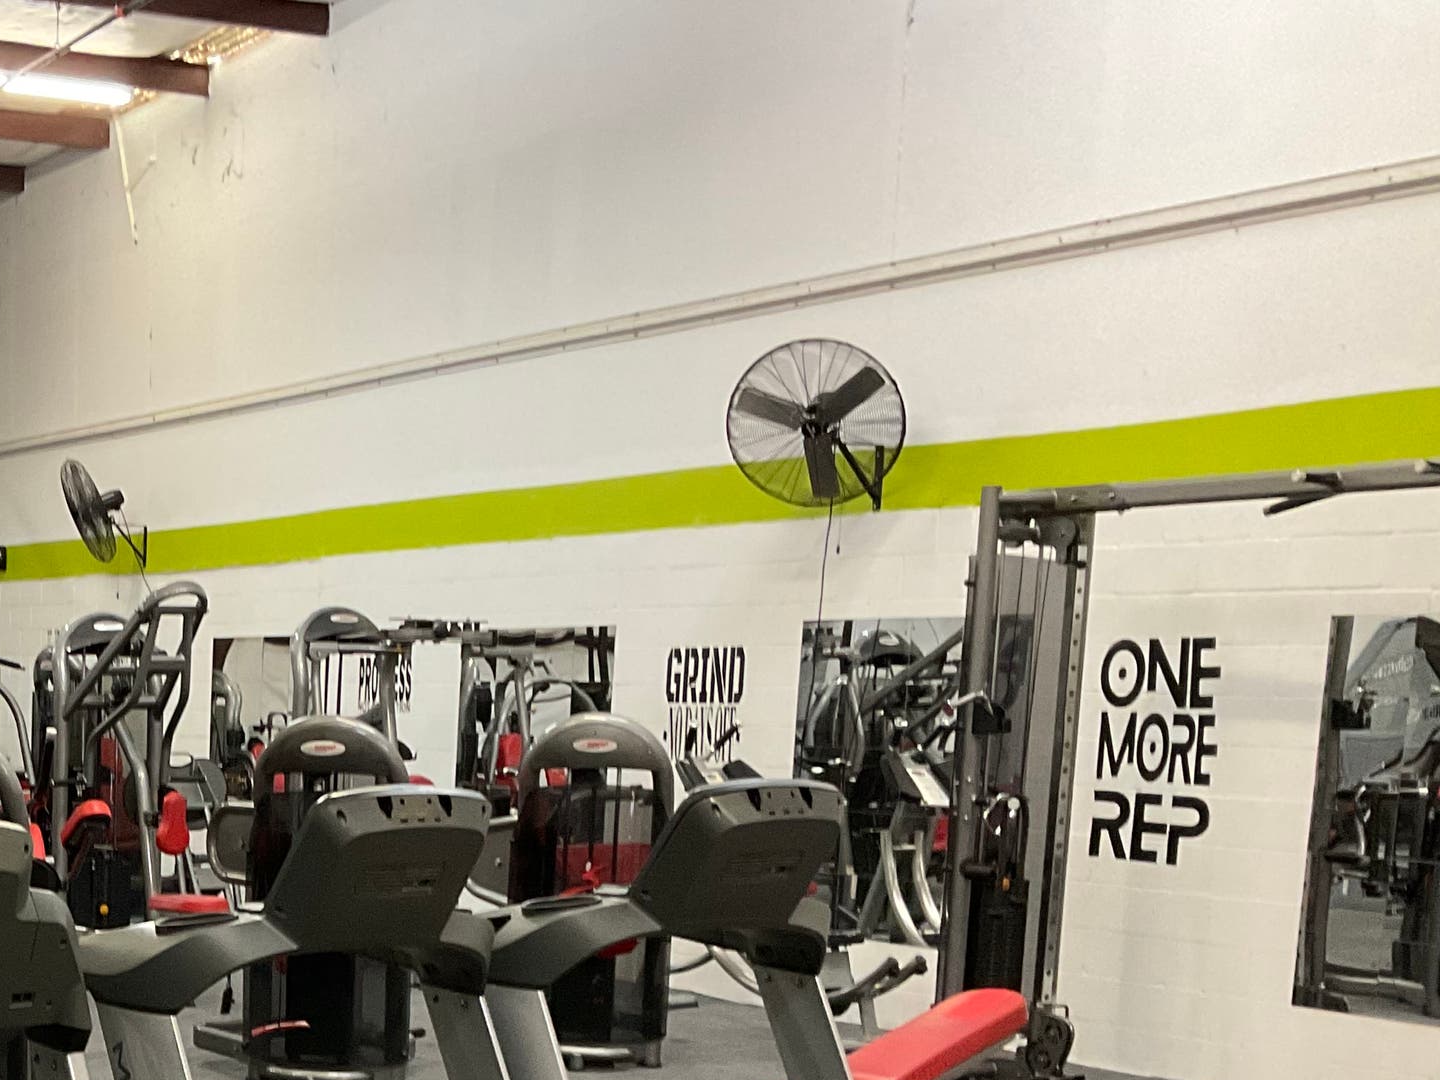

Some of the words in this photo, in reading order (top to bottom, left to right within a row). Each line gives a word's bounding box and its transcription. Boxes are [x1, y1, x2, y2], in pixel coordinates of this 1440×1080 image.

[359, 657, 412, 702] PROESS
[666, 647, 745, 703] GRIND
[1100, 637, 1221, 709] ONE
[1096, 712, 1217, 785] MORE
[1088, 790, 1210, 866] REP
